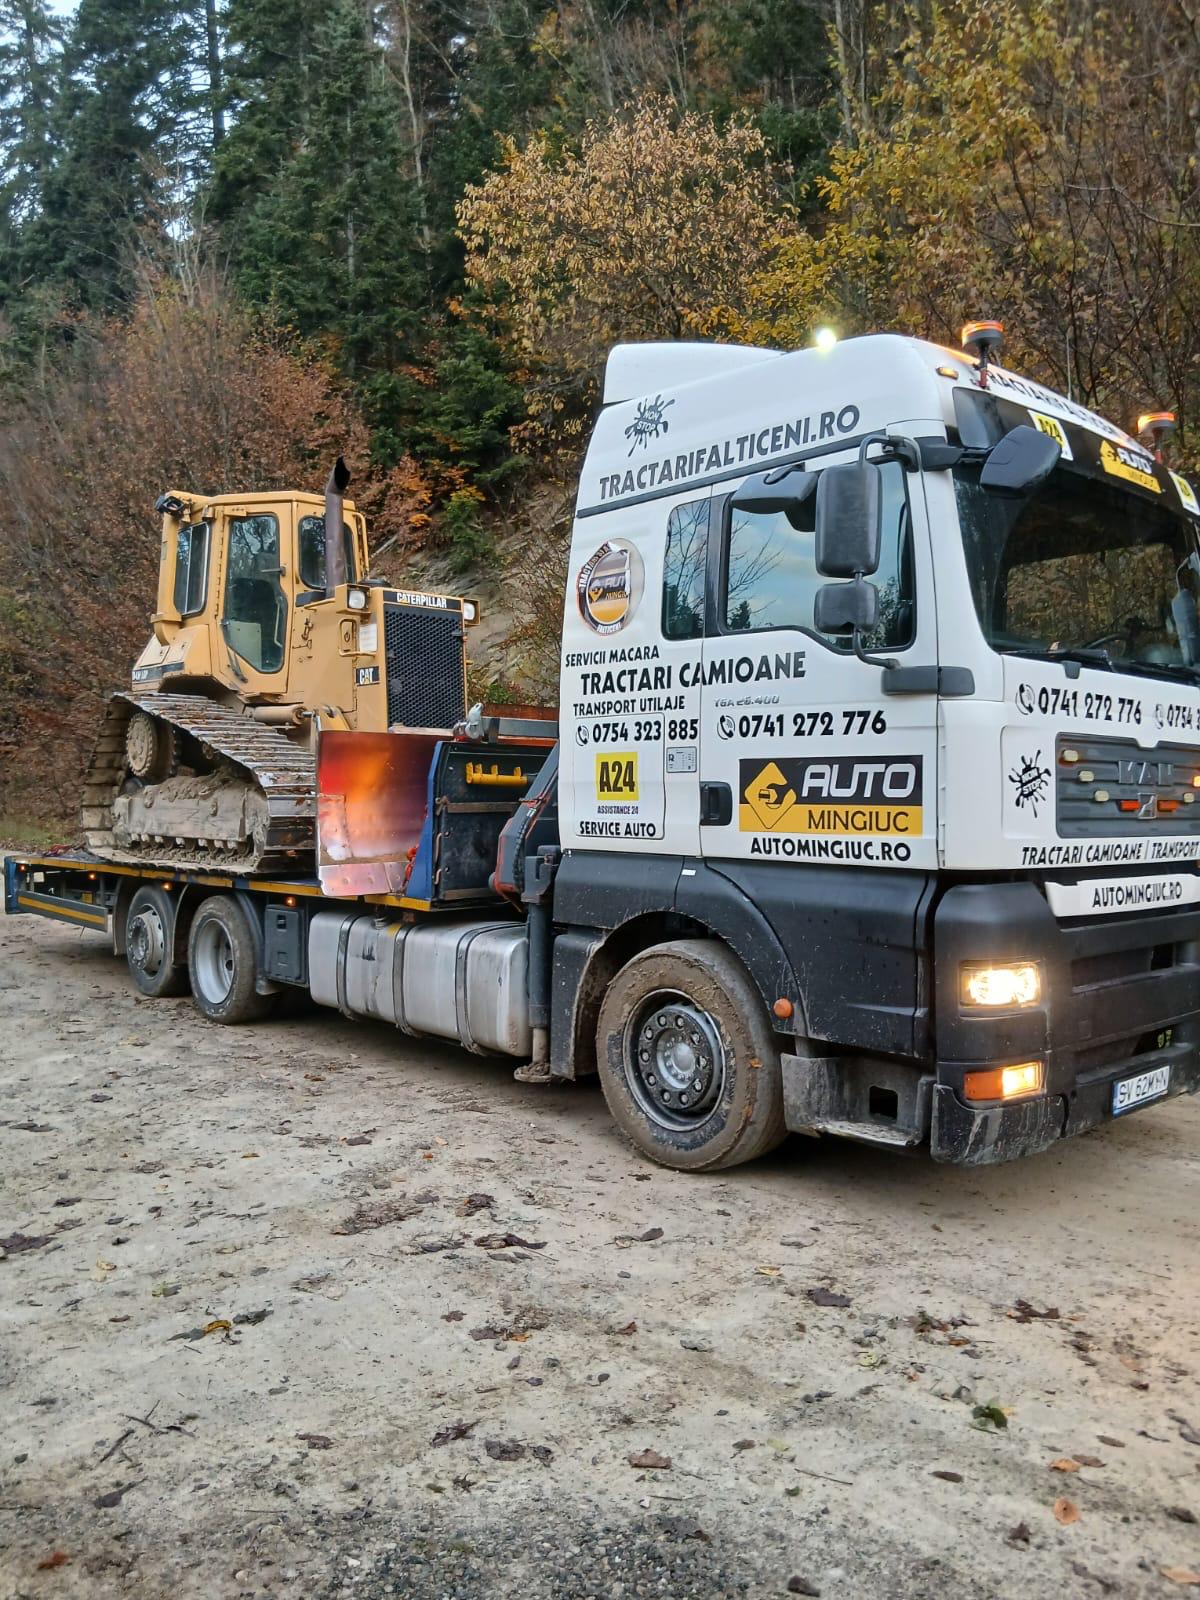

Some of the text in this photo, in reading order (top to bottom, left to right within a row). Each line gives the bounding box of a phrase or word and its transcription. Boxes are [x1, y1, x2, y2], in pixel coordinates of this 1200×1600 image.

[637, 421, 656, 432] STOP
[600, 404, 860, 499] TRACTARIFALTICENI.RO
[396, 592, 447, 608] CATERPILLAR
[565, 645, 660, 667] SERVICII MACARA
[360, 668, 373, 685] CAT
[581, 651, 807, 695] TRACTARI CAMIOANE
[573, 695, 685, 717] TRANSPORT UTILAJE
[1038, 686, 1142, 725] 0741 272 776
[1166, 703, 1193, 730] 0754
[592, 719, 699, 743] 0754 323 885
[738, 710, 887, 738] 0741 272 776
[599, 760, 635, 793] A24
[801, 763, 916, 798] AUTO
[597, 805, 631, 815] ASSISTANCE
[808, 809, 909, 832] MINGIUC
[579, 821, 656, 837] SERVICE AUTO
[750, 837, 911, 862] AUTOMINGIUC.RO
[1021, 845, 1083, 866] TRACTARI
[1085, 842, 1144, 864] CAMIOANE
[1092, 881, 1183, 908] AUTOMINGIUC.RO
